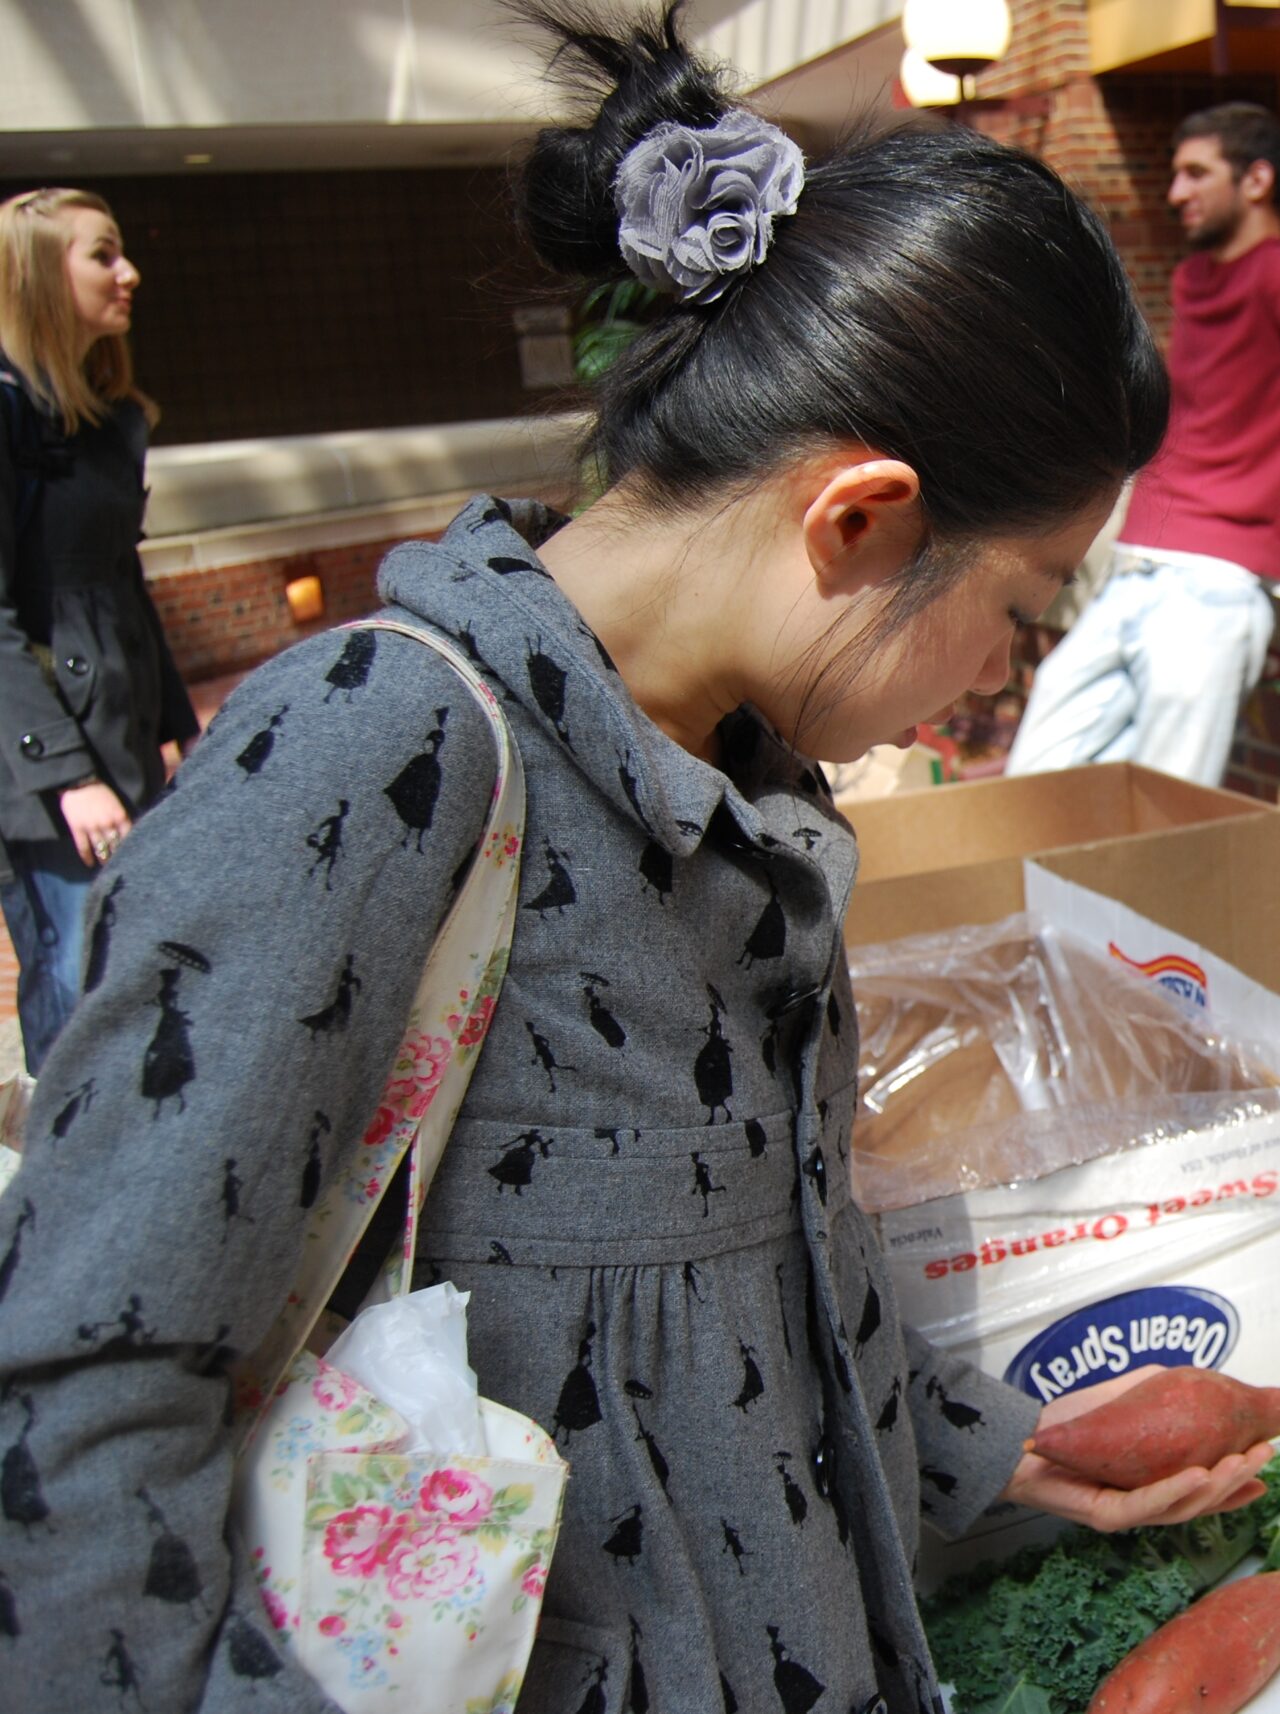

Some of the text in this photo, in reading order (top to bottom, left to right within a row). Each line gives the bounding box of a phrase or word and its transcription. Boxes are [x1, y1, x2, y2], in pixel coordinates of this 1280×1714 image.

[924, 1170, 1279, 1280] Sweet Oranges
[1029, 1315, 1227, 1404] Ocean Spray
